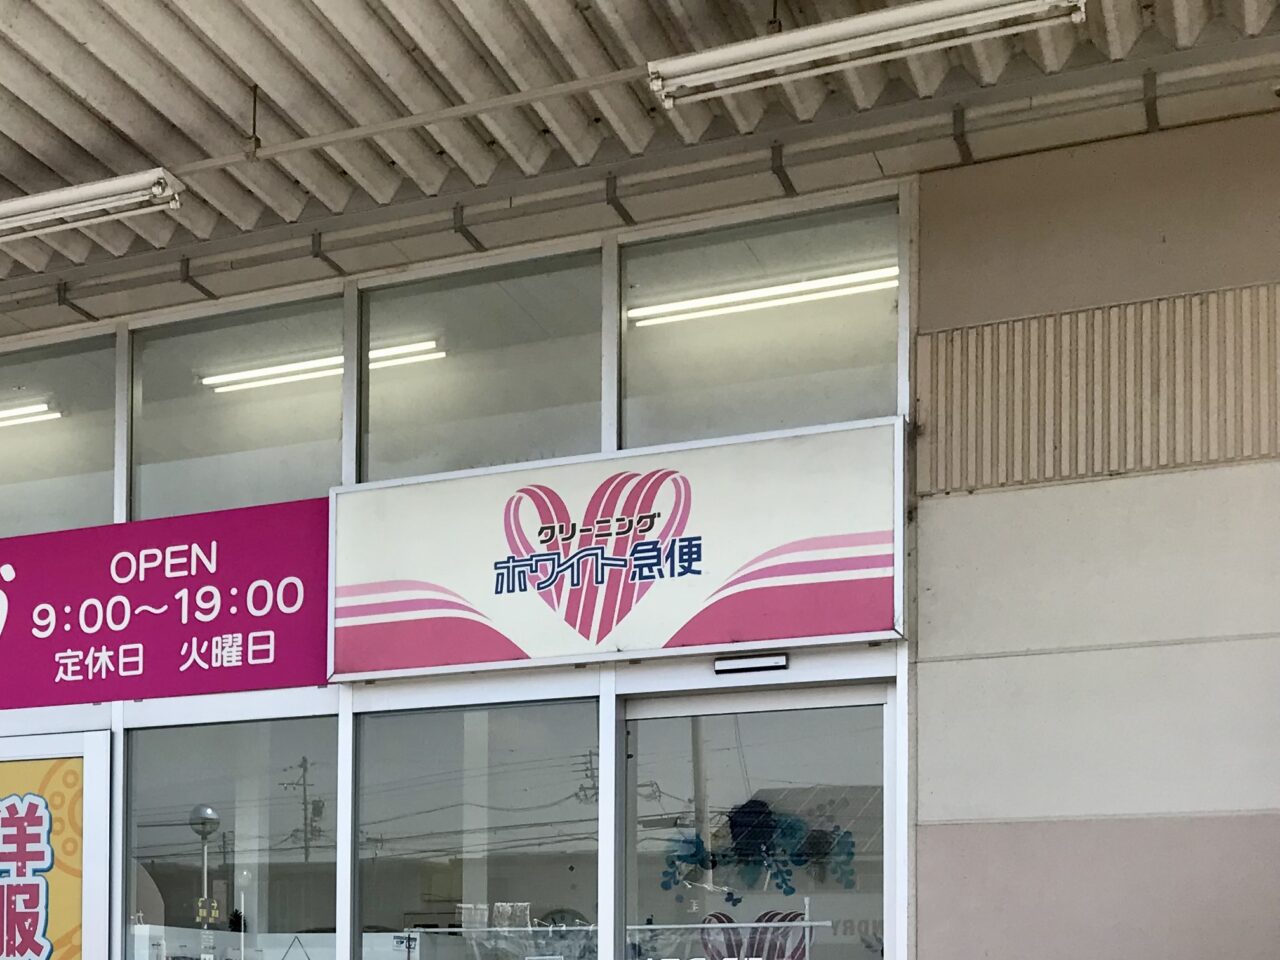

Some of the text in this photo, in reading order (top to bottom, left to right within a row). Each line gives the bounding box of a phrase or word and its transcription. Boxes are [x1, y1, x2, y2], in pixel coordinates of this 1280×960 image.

[537, 512, 661, 544] クリーニング
[110, 541, 218, 584] OPEN
[494, 536, 702, 595] ホワイト急便
[54, 631, 276, 683] 定休日 火曜日
